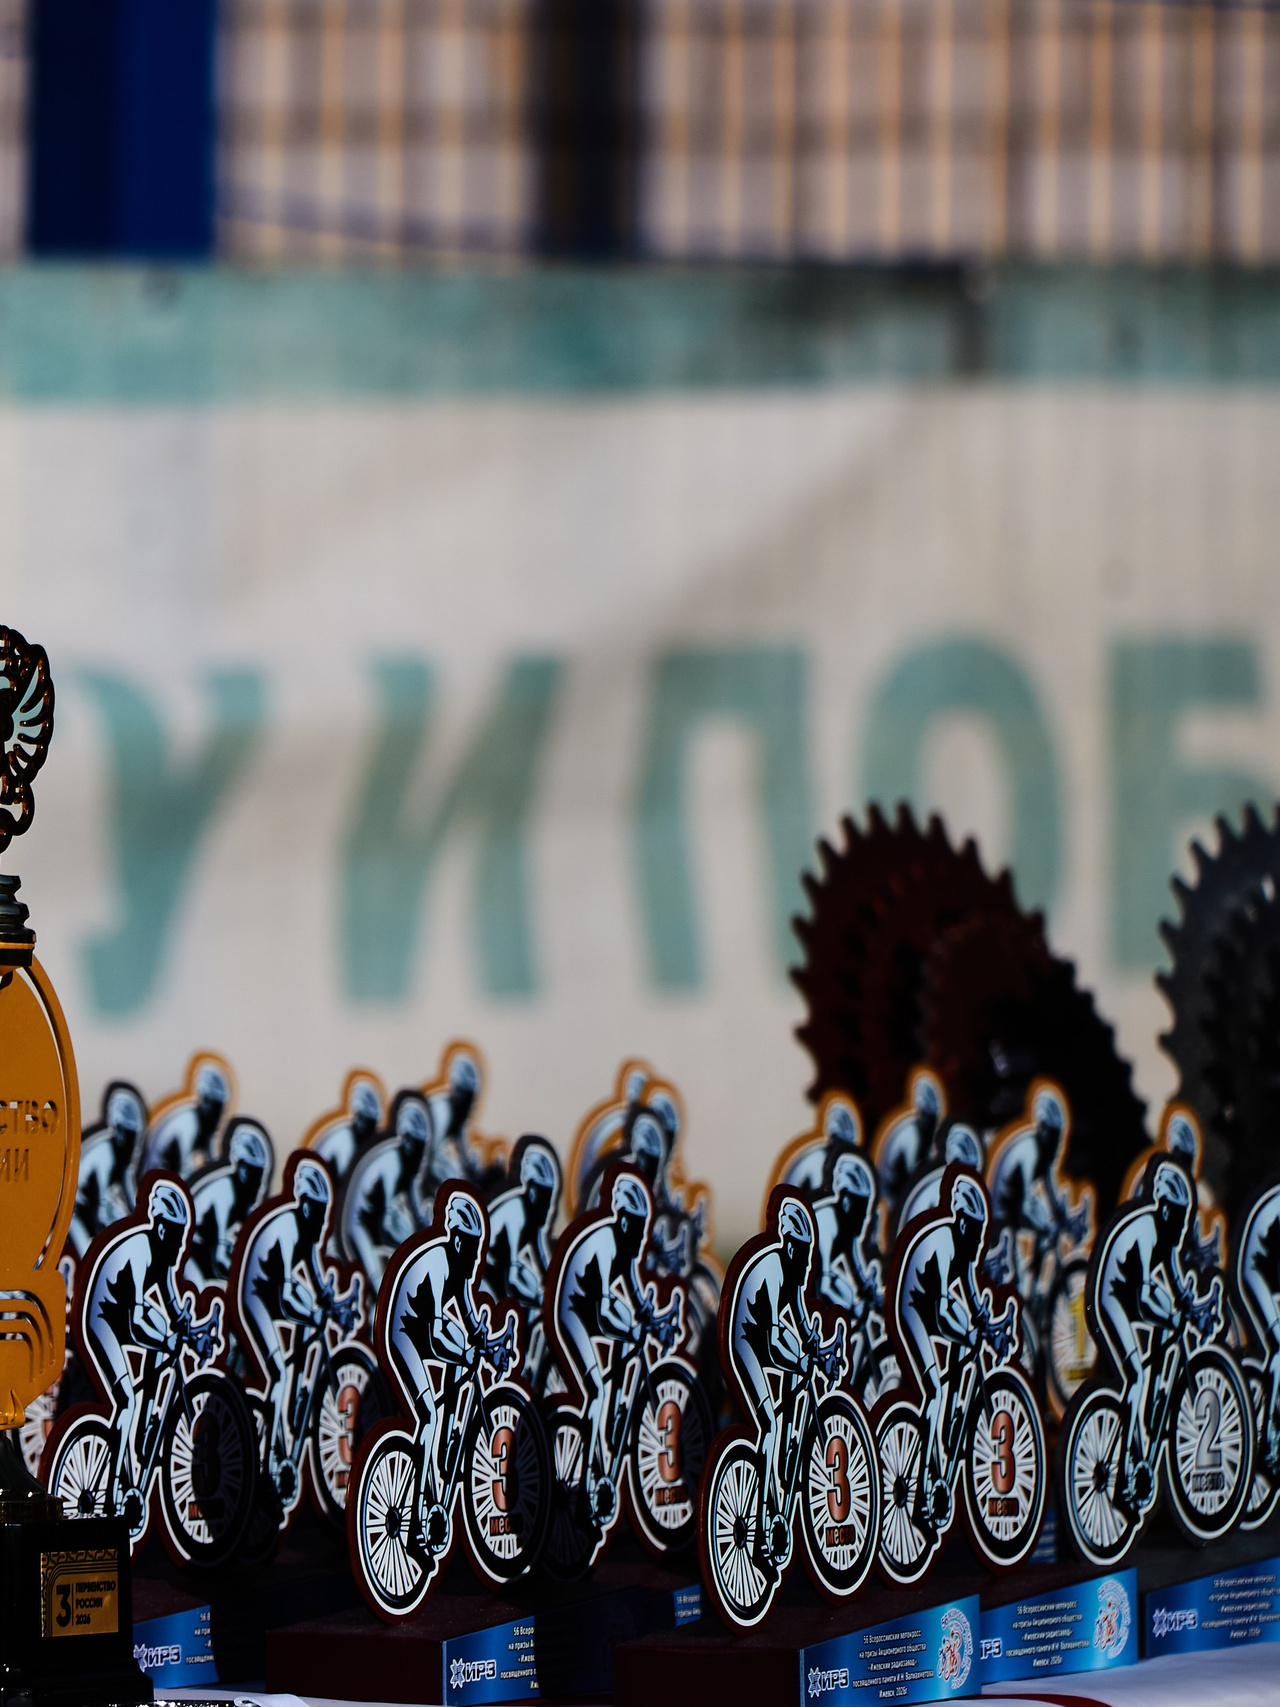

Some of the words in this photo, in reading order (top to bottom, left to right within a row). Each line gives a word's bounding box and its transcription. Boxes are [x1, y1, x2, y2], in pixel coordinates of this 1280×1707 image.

[336, 650, 562, 1010] И
[1195, 1388, 1220, 1469] 2
[659, 1402, 682, 1482] 3
[991, 1411, 1016, 1494] 3
[492, 1427, 519, 1512] 3
[826, 1437, 851, 1522] 3
[988, 1498, 1019, 1517] место
[826, 1526, 856, 1548] место
[76, 1581, 116, 1593] ПЕРВЕНСТВО
[56, 1584, 71, 1627] 3
[76, 1598, 103, 1609] РОССИИ
[76, 1614, 91, 1626] 2026
[148, 1644, 181, 1667] ИРЗ
[466, 1659, 497, 1683] ИРЗ
[820, 1668, 849, 1691] ИРЗ
